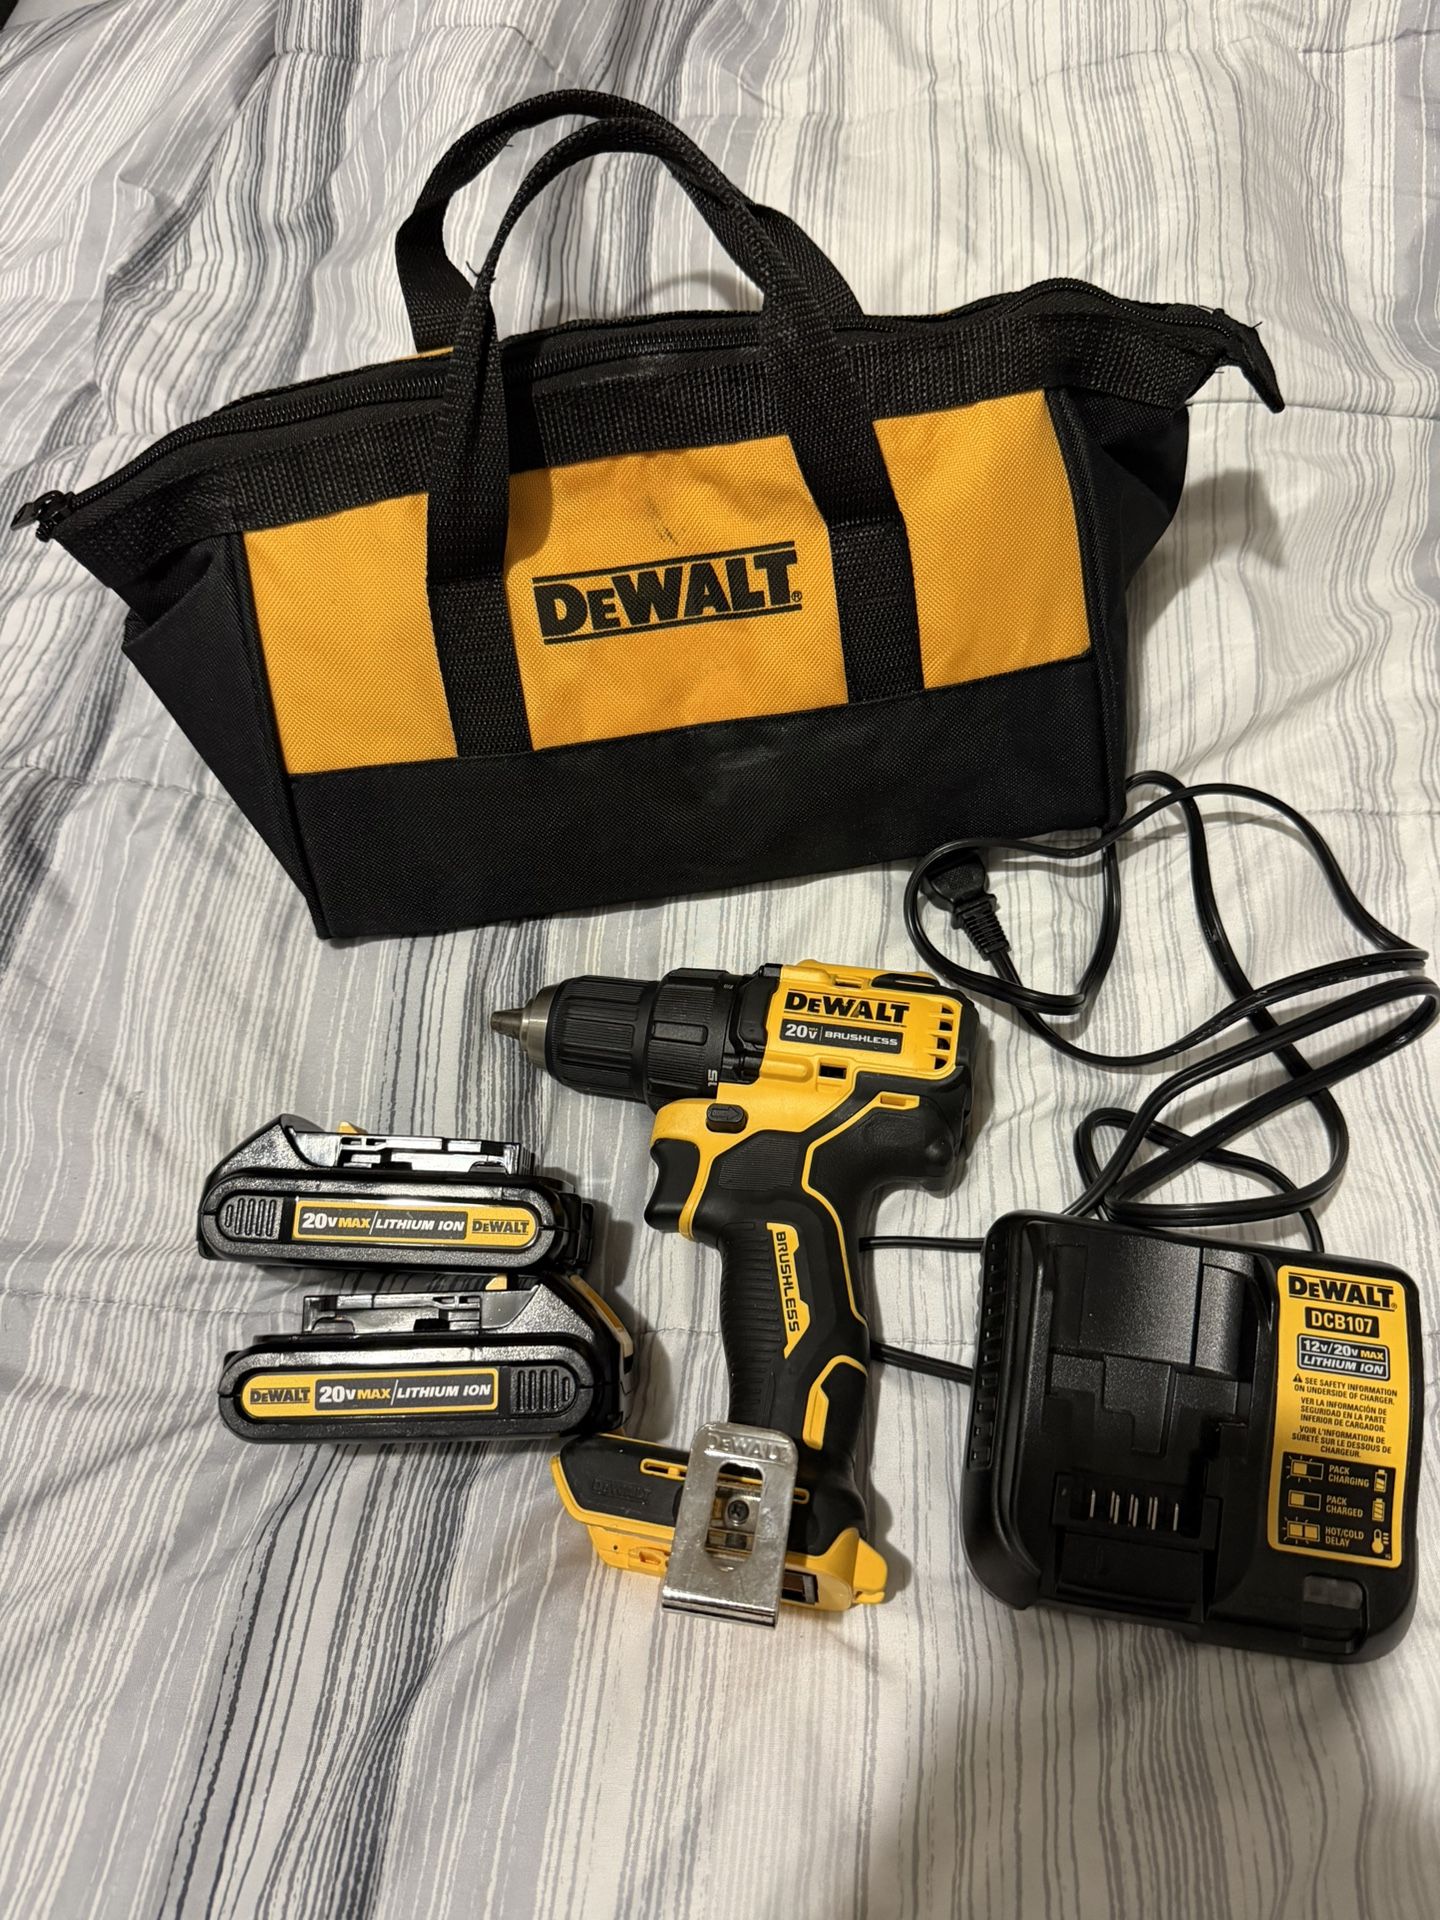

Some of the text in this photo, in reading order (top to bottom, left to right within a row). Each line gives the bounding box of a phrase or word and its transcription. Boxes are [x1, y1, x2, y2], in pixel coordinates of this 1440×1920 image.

[784, 991, 909, 1023] DEWALT
[824, 1030, 898, 1046] BRUSHLESS
[708, 1069, 718, 1087] 15
[438, 1221, 465, 1232] ION
[472, 1219, 529, 1234] DEWALT
[776, 1231, 800, 1332] BRUSHLESS
[1311, 1310, 1373, 1334] DCB107
[1360, 1350, 1384, 1361] MAX
[1303, 1355, 1384, 1375] LITHIUM ION
[463, 1384, 491, 1396] ION
[1294, 1384, 1394, 1405] ON UNDERSIDE OF CHARGER.
[1305, 1377, 1397, 1397] SEE SAFETY INFORMATION
[250, 1388, 311, 1404] DEWALT
[1301, 1397, 1314, 1405] VER
[1326, 1400, 1376, 1414] INFORMACIÓN
[1301, 1405, 1386, 1424] SEGURIDAD EN LA PARTE
[1301, 1414, 1332, 1425] INFERIOR
[1345, 1420, 1385, 1432] CARGADOR.
[1300, 1425, 1384, 1444] VOIR L'INFORMATION DE
[1320, 1446, 1360, 1458] CHARGEUR.
[1321, 1437, 1335, 1446] SUR
[1347, 1440, 1380, 1452] DESSOUS
[1382, 1446, 1391, 1454] DE
[1329, 1464, 1350, 1475] PACK
[1328, 1473, 1370, 1488] CHARGING
[1326, 1494, 1347, 1506] PACK
[1326, 1504, 1364, 1518] CHARGED
[1325, 1526, 1364, 1540] HOT/COLD
[1325, 1536, 1350, 1548] DELAY
